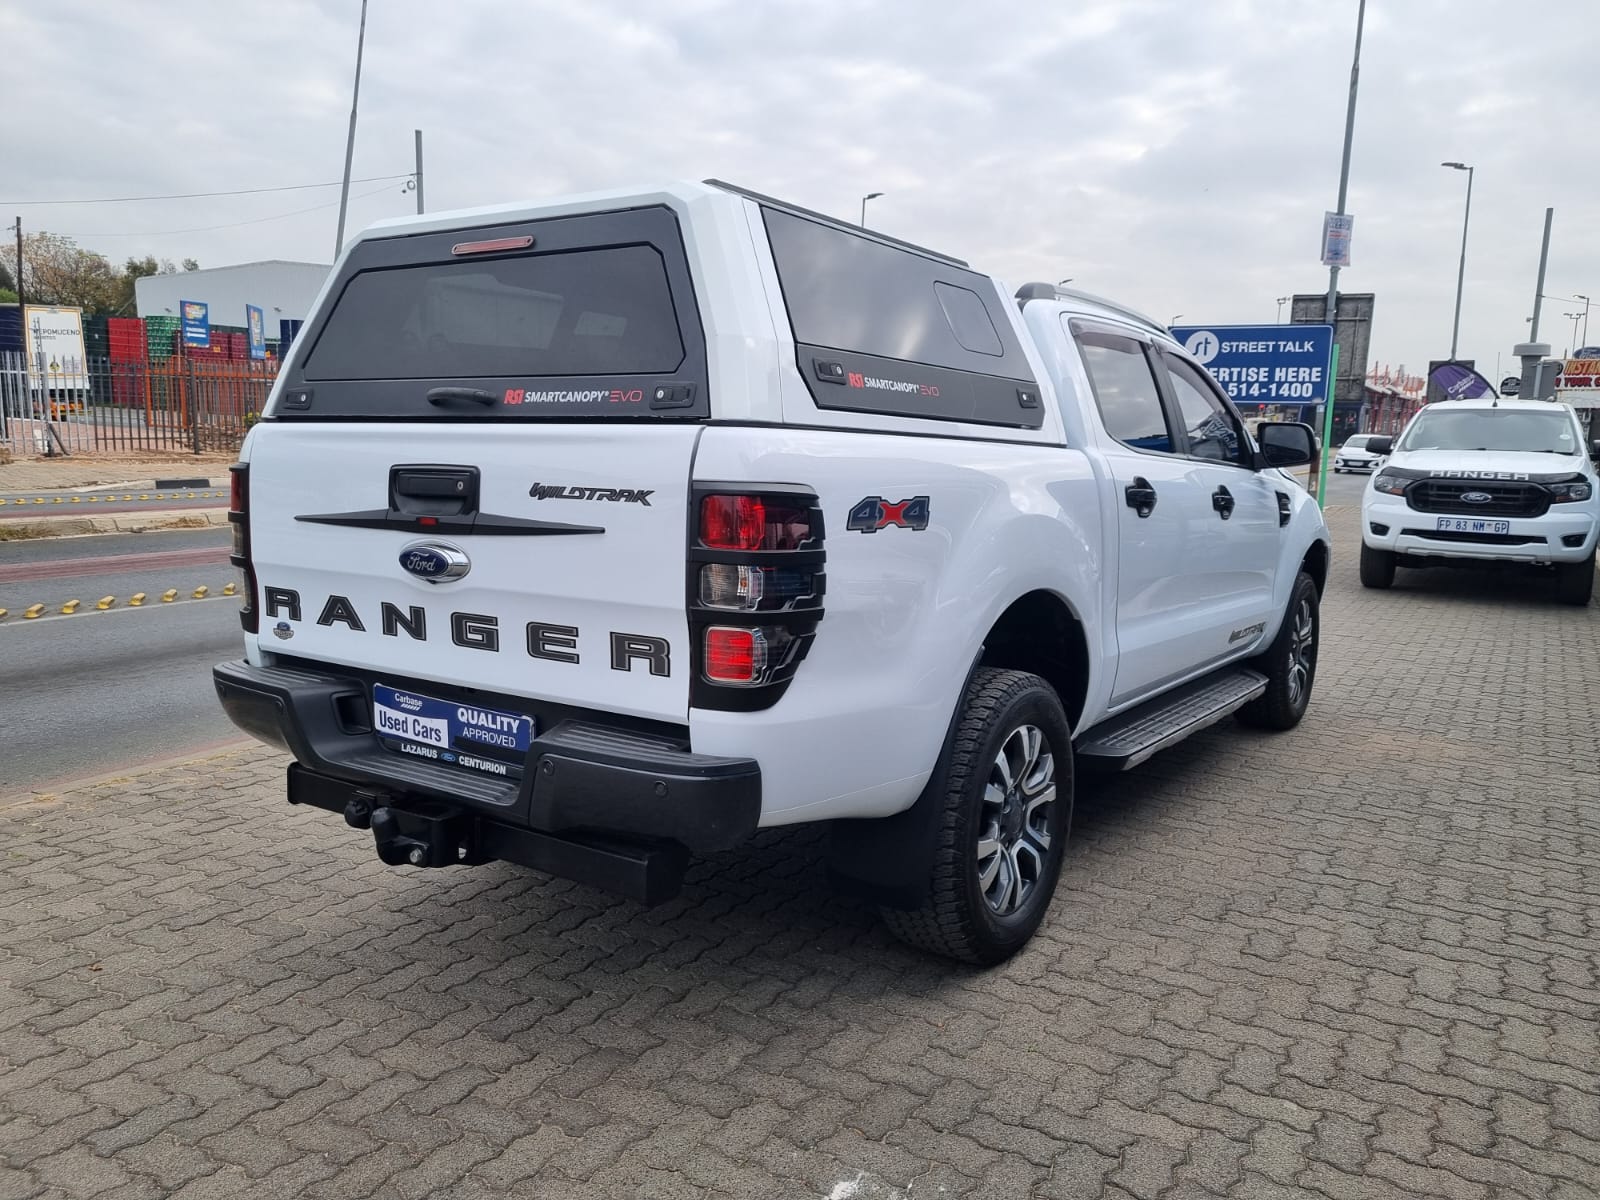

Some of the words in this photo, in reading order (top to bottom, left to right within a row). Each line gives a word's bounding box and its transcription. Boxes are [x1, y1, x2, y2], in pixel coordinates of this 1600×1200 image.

[1221, 341, 1274, 353] STREET
[1278, 340, 1315, 352] TALK
[1274, 367, 1322, 382] HERE
[504, 389, 525, 404] RSI
[609, 389, 643, 402] EVO
[920, 385, 940, 396] EVO
[1228, 382, 1313, 397] 514-1400
[529, 482, 655, 507] WILDTRAK
[1439, 519, 1451, 529] FP
[1455, 521, 1468, 531] 83
[1472, 521, 1486, 532] NM
[1494, 523, 1508, 533] GP
[407, 551, 437, 571] Ford
[264, 585, 672, 678] RANGER
[394, 693, 423, 707] Carbase
[379, 710, 409, 735] Used
[412, 718, 442, 742] Cars
[457, 708, 520, 734] QUALITY
[462, 726, 516, 748] APPROVED
[401, 743, 438, 759] LAZARUS
[458, 755, 507, 775] CENTURION
